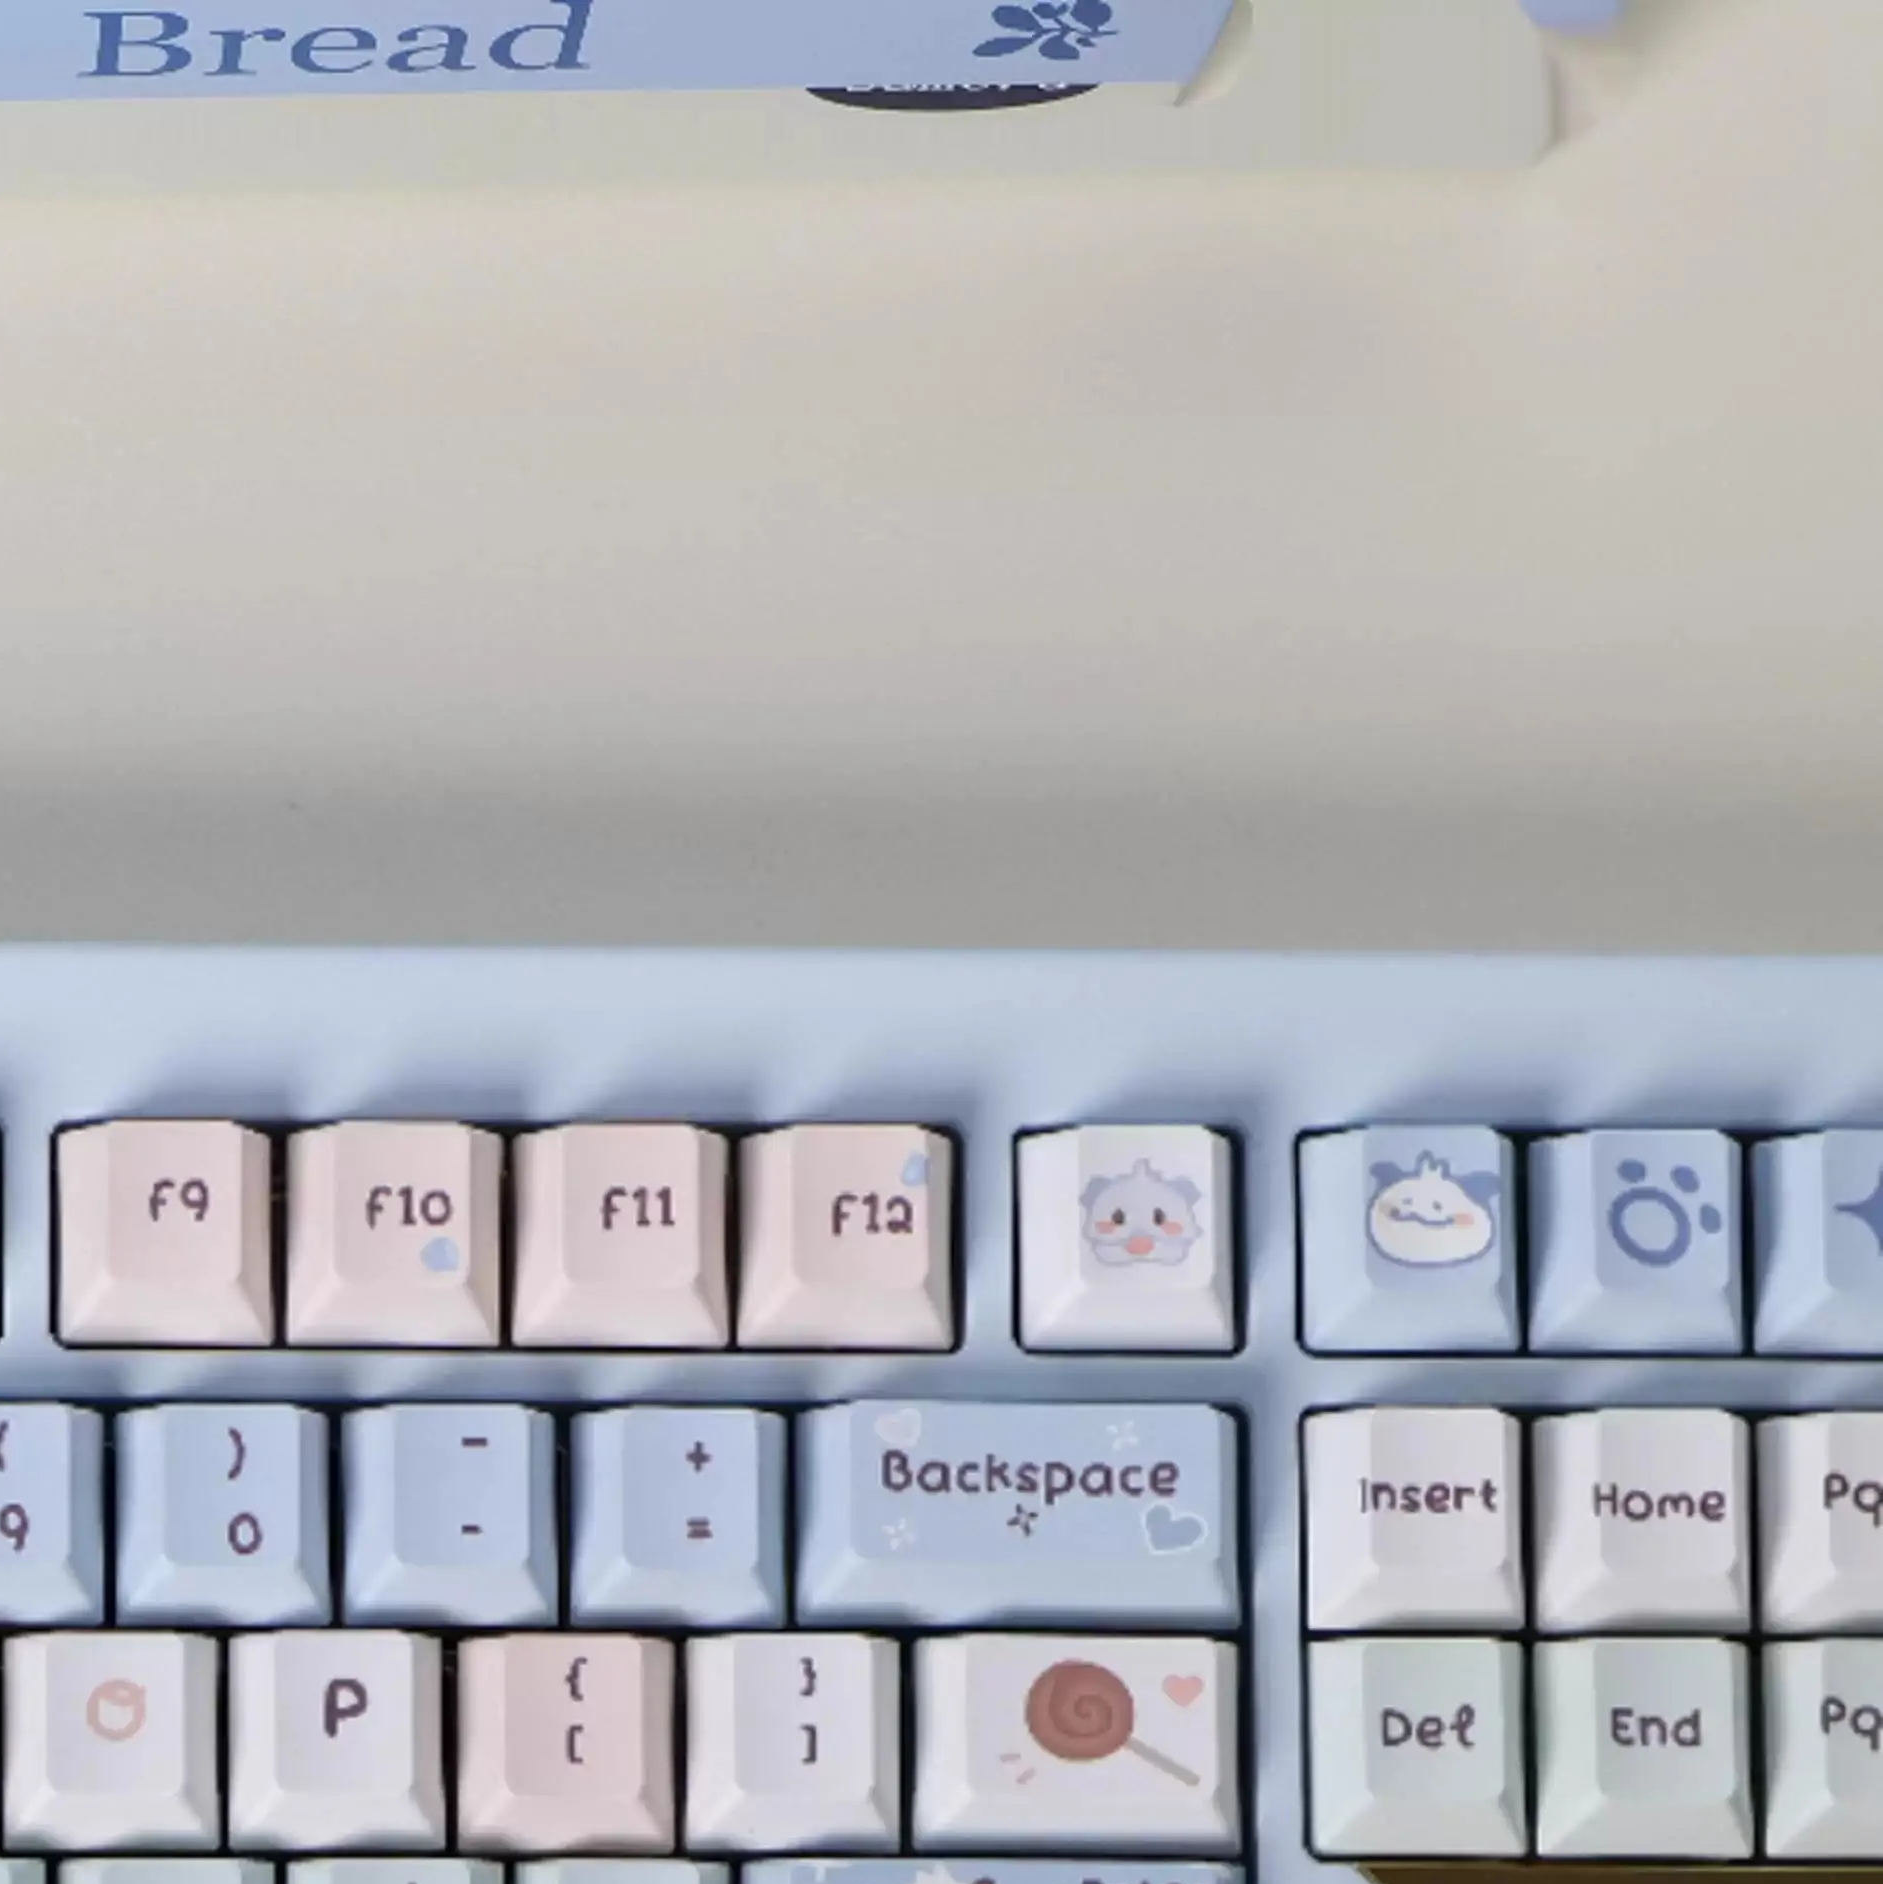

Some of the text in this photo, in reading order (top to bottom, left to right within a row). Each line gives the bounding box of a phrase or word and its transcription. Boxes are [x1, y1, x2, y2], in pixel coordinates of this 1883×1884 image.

[80, 0, 593, 76] Bread
[149, 1179, 208, 1221] F9
[366, 1186, 452, 1229] F10
[602, 1187, 674, 1230] F11
[832, 1193, 912, 1236] F12
[228, 1428, 245, 1480] )
[686, 1442, 710, 1472] +
[880, 1450, 1180, 1503] Backspace
[1362, 1479, 1496, 1513] Insert
[1594, 1483, 1725, 1522] Home
[0, 1504, 29, 1551] 9
[228, 1513, 262, 1555] 0
[687, 1518, 712, 1539] =
[565, 1658, 587, 1701] {
[800, 1658, 816, 1696] }
[86, 1679, 146, 1742] O
[324, 1679, 367, 1738] P
[1381, 1705, 1474, 1748] Del
[1611, 1707, 1700, 1747] End
[567, 1725, 583, 1763] [
[802, 1725, 817, 1764] ]
